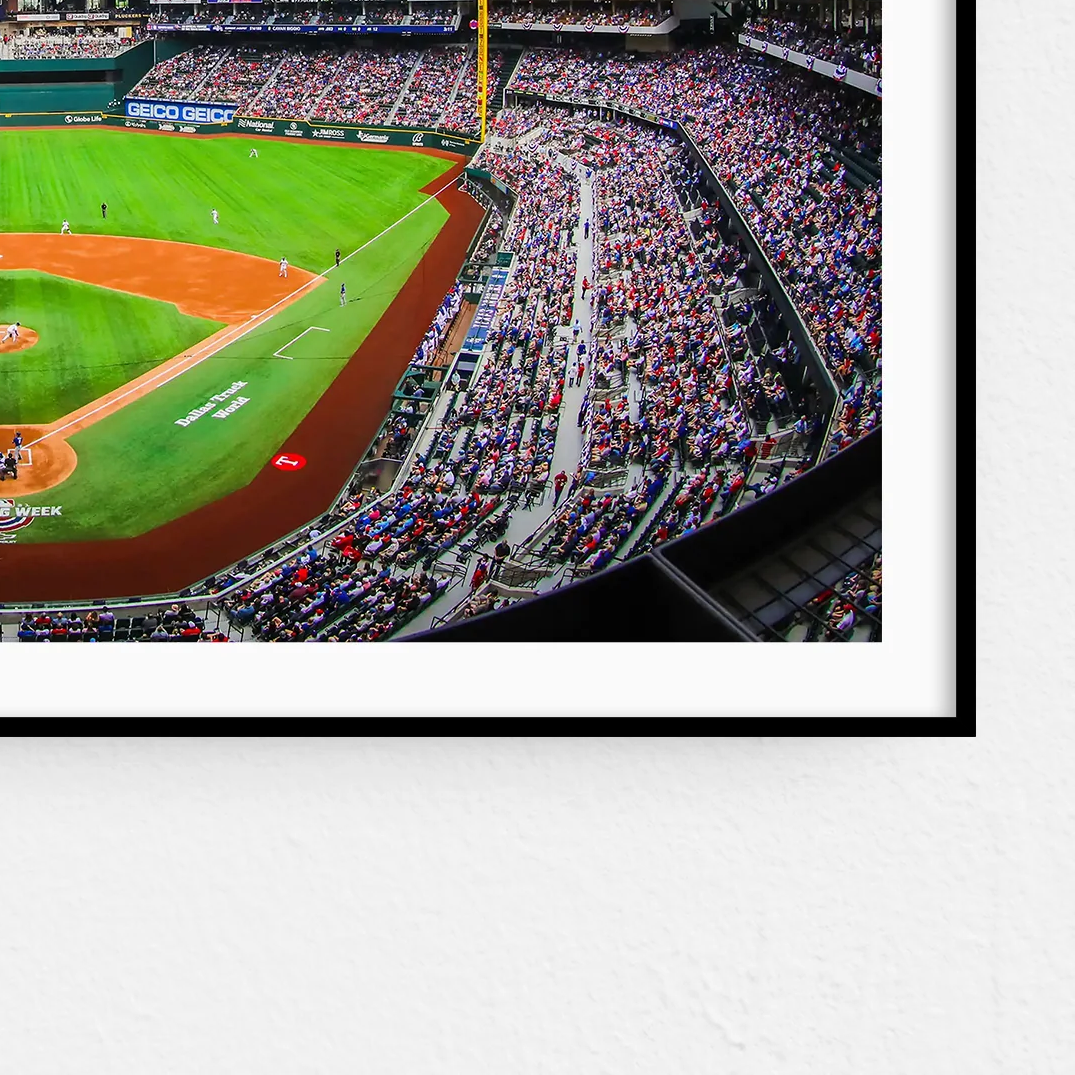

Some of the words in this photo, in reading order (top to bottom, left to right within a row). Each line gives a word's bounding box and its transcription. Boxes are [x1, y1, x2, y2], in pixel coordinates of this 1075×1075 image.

[128, 102, 179, 120] GEICO
[174, 402, 216, 427] Dallas
[210, 380, 248, 402] Truck
[212, 396, 250, 418] World
[276, 456, 298, 466] T
[16, 506, 62, 517] WEEK
